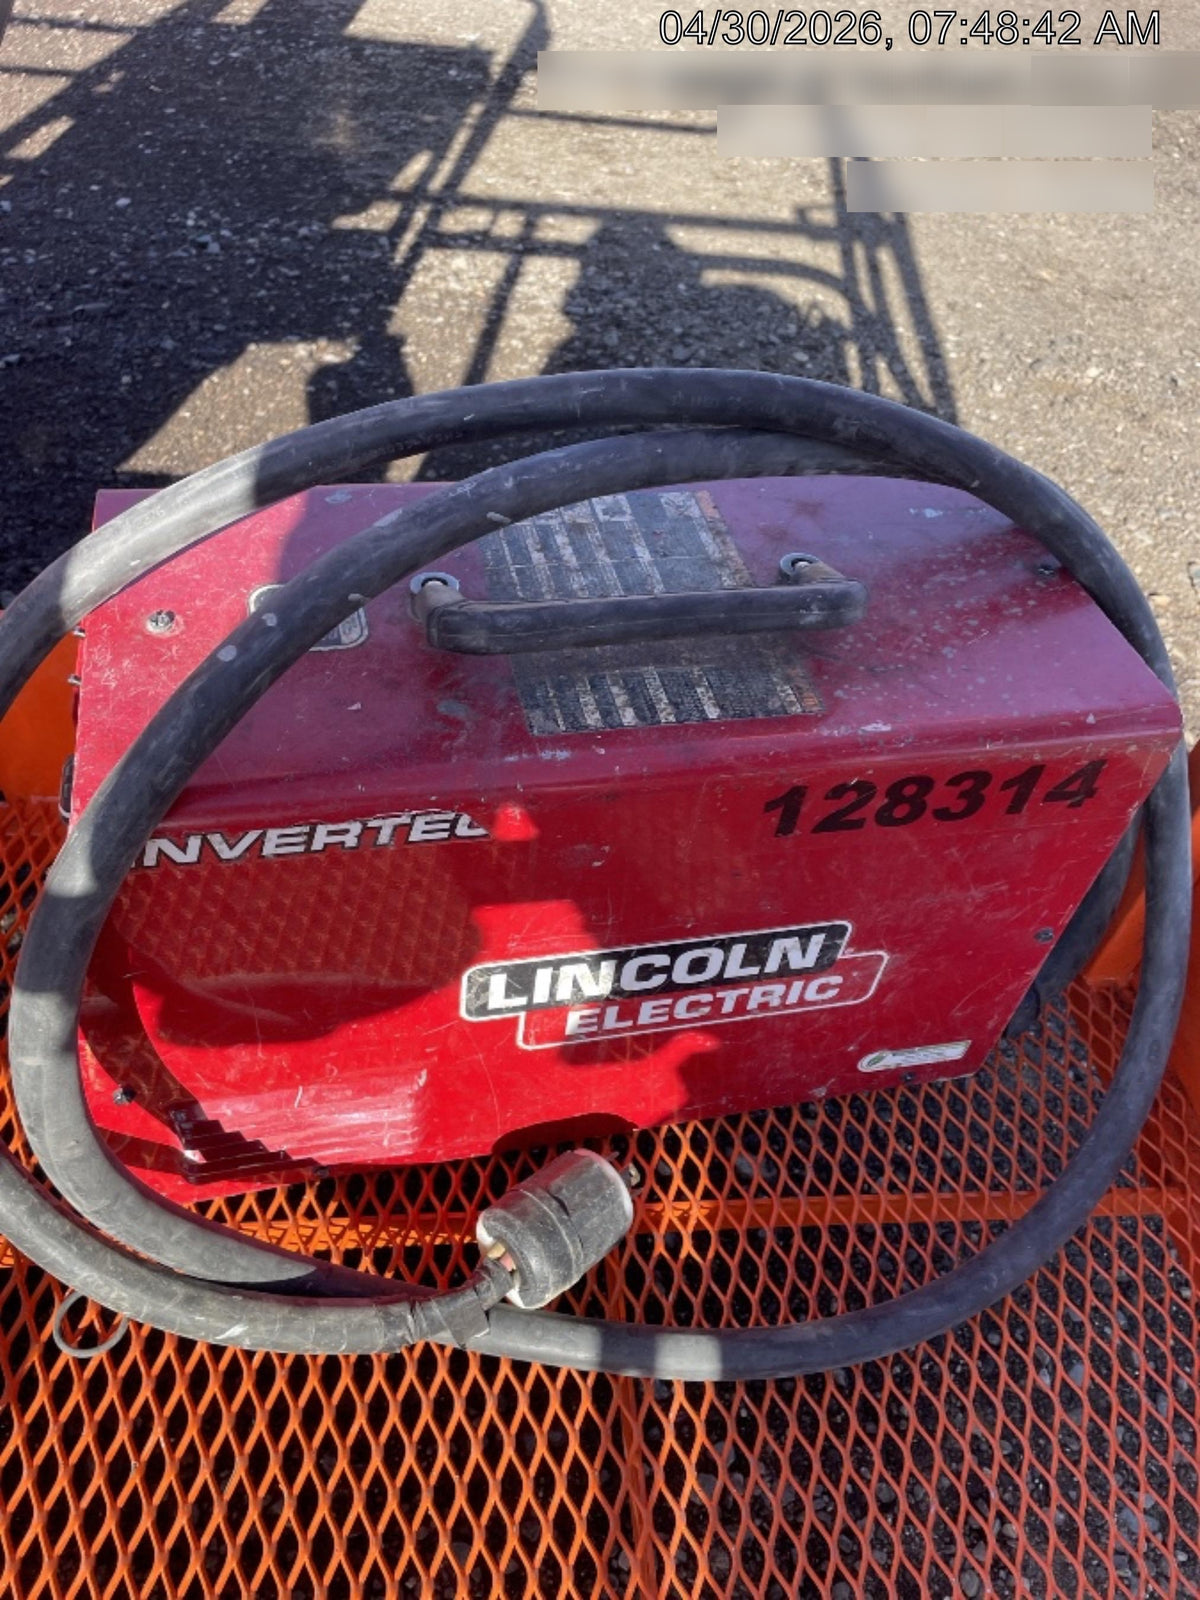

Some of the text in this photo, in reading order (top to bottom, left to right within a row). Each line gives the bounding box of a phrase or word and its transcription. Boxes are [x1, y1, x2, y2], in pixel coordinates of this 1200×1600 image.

[763, 759, 1108, 838] 128314
[488, 933, 827, 1011] LINCOLN
[564, 975, 844, 1036] ELECTRIC
